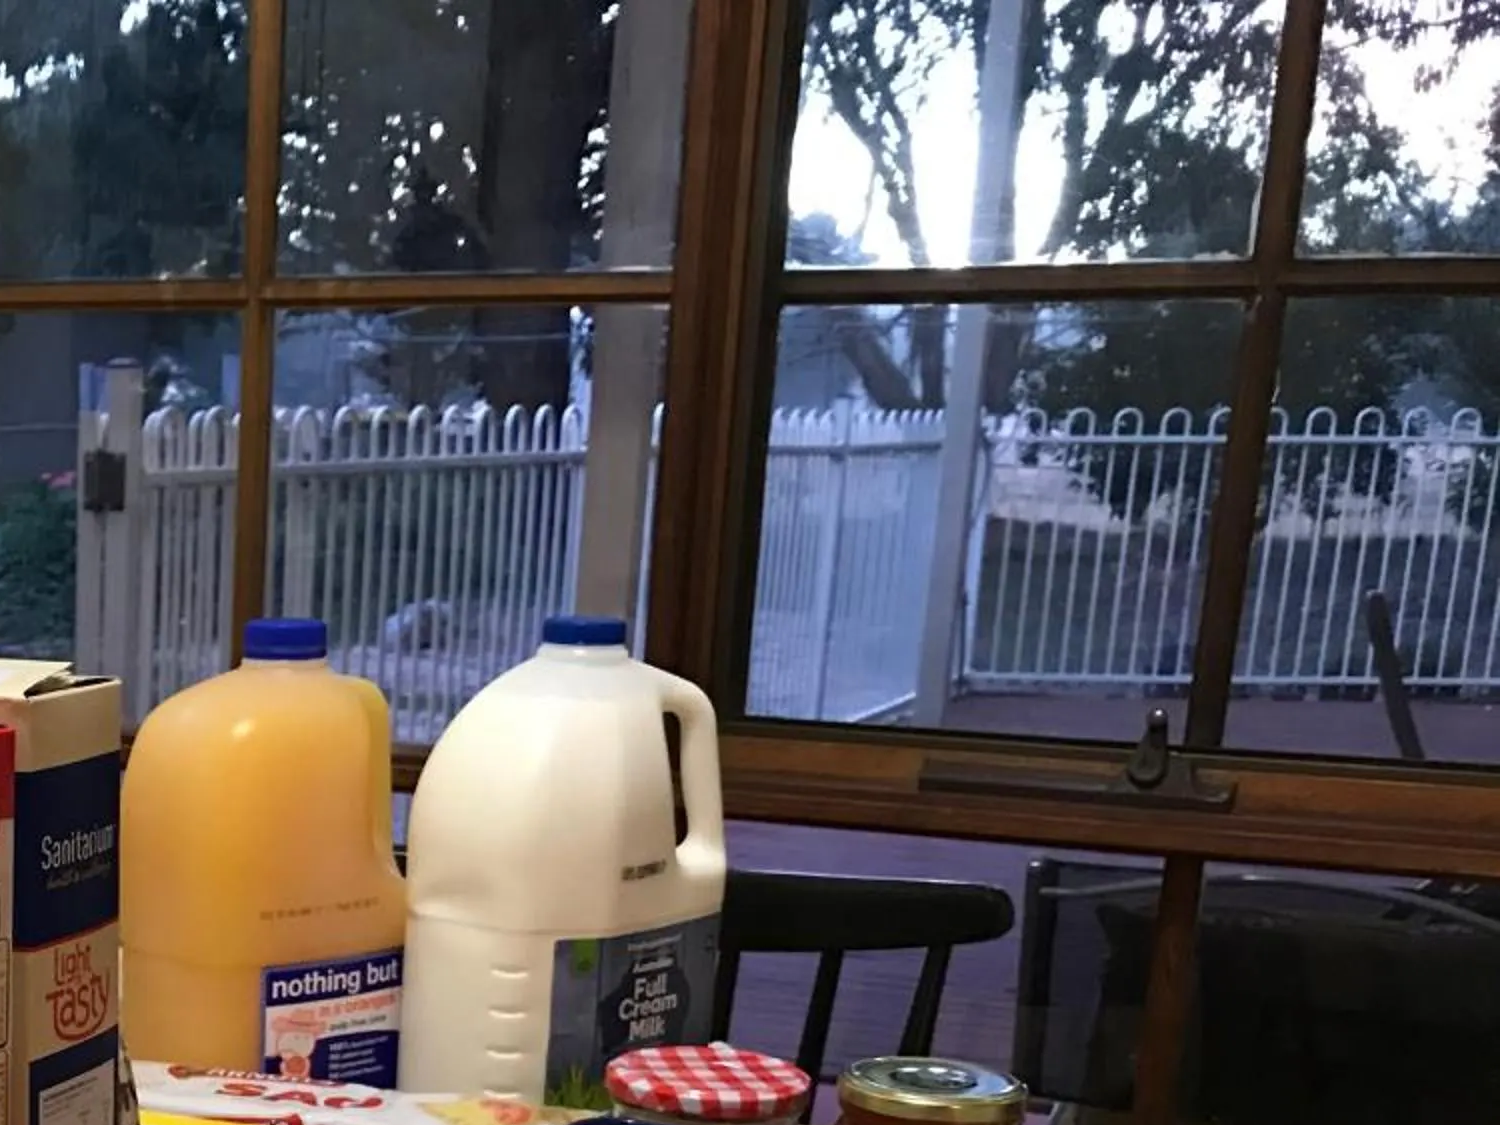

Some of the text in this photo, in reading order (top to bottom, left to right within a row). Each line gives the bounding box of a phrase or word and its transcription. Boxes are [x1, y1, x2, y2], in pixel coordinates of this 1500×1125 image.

[41, 823, 113, 870] Sanitarium
[272, 959, 398, 999] nothing but
[635, 973, 668, 999] Full
[619, 994, 678, 1021] Cream
[629, 1017, 666, 1041] Milk
